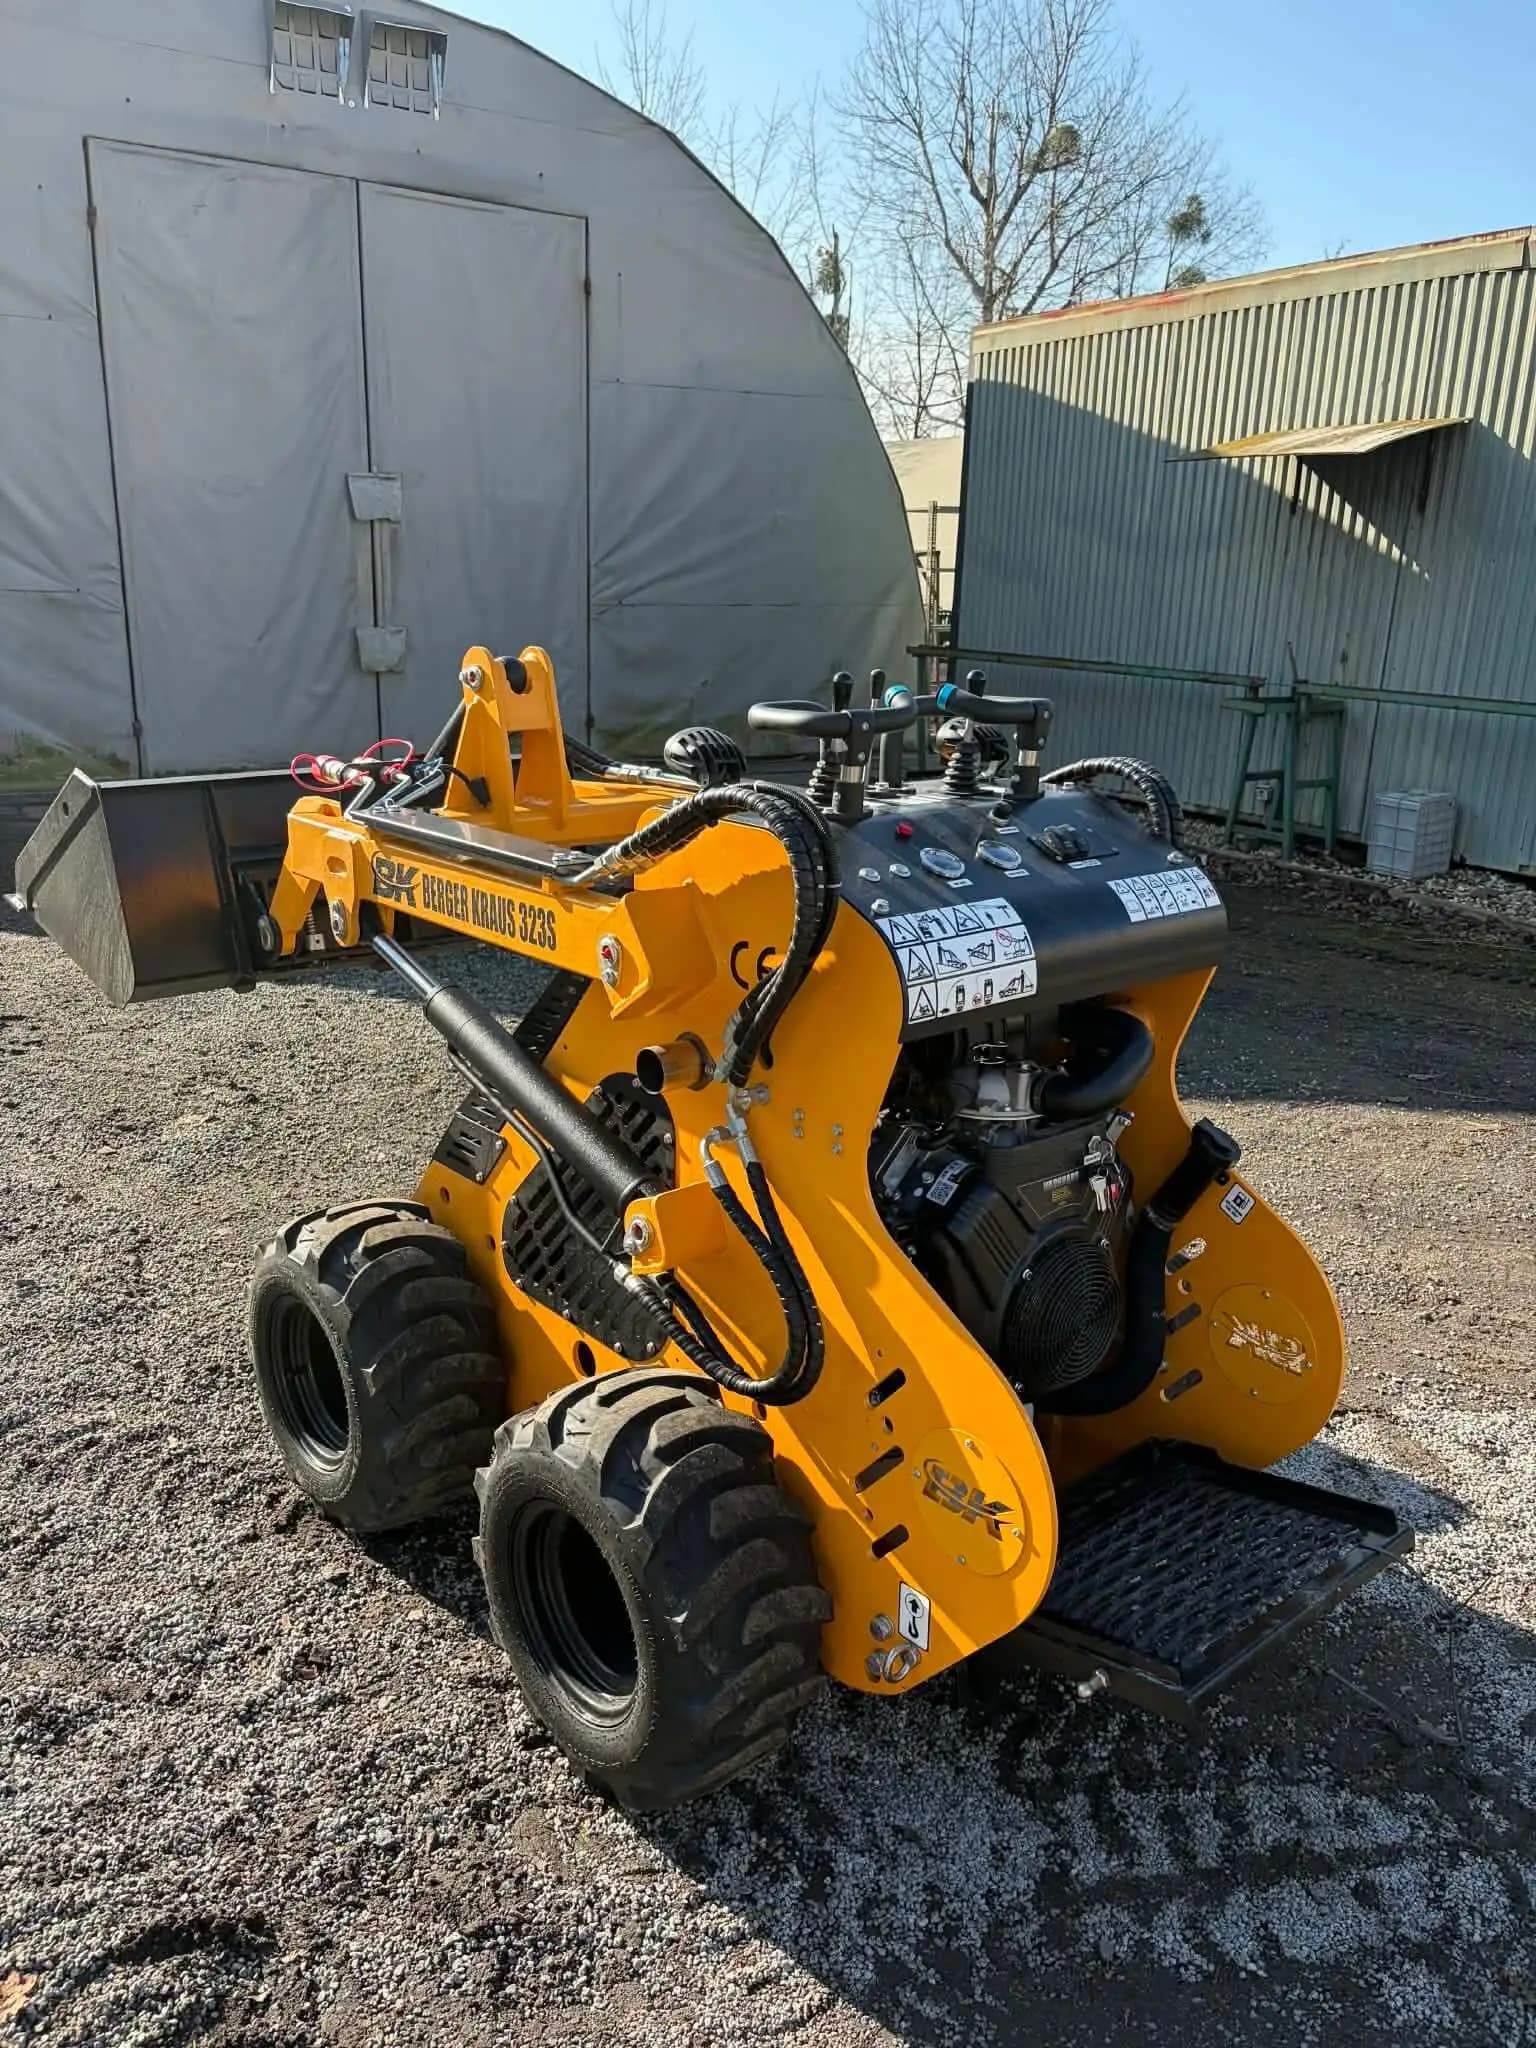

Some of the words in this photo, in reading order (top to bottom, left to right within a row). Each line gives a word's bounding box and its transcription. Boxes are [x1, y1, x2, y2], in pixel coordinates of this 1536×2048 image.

[372, 852, 420, 908] BK
[422, 873, 469, 922] BERGER
[471, 887, 516, 939] KRAUS
[518, 902, 557, 951] 323S
[730, 940, 778, 991] CE
